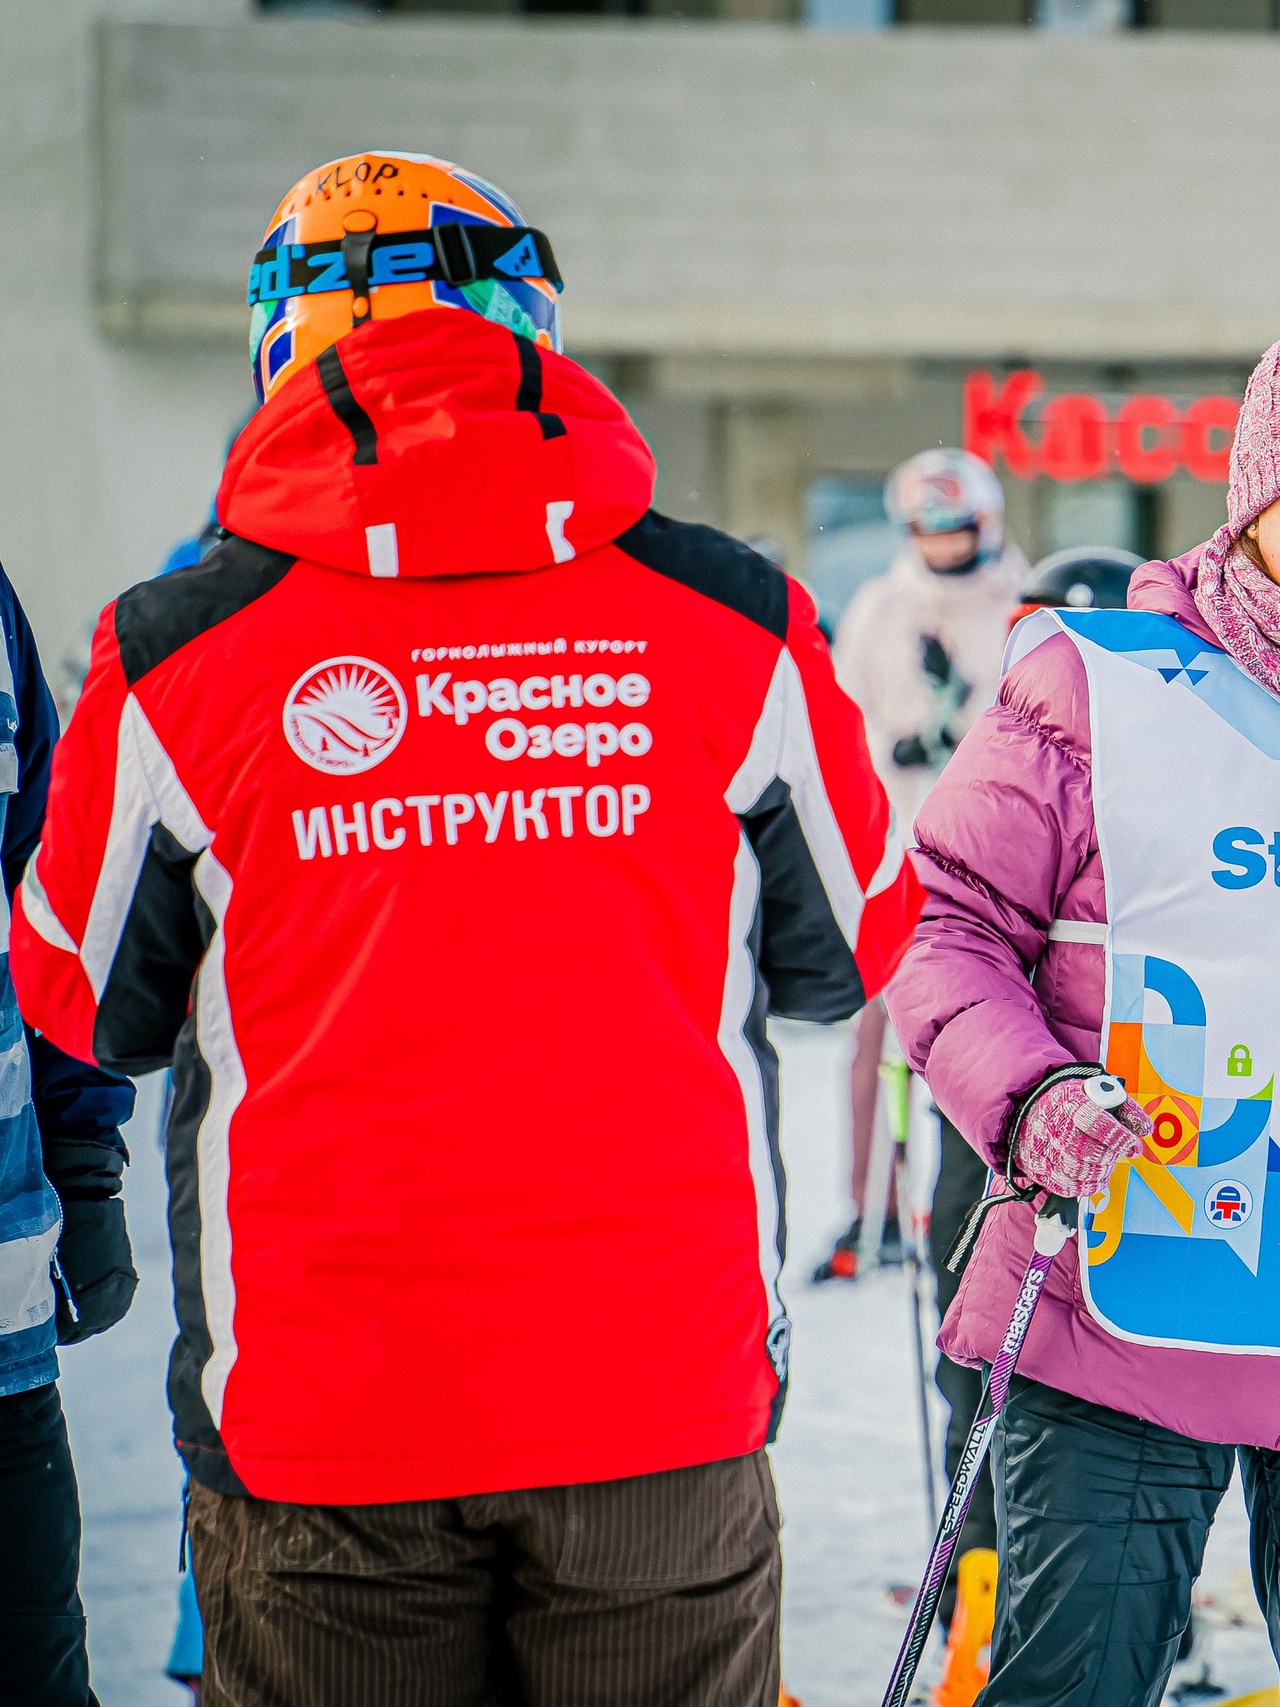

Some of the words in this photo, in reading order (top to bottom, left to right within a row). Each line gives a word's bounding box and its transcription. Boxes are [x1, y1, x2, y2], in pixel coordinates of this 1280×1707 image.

[315, 162, 399, 196] KLOP
[963, 369, 1242, 483] Касс
[411, 637, 567, 662] ГОРНОЛЫЖНЫЙ
[574, 639, 648, 654] КУРОРТ
[415, 672, 651, 725] Красное
[485, 717, 653, 767] Озеро
[291, 784, 650, 860] ИНСТРУКТОР
[1002, 1268, 1045, 1354] masters
[942, 1422, 990, 1534] SPEEDWALL
